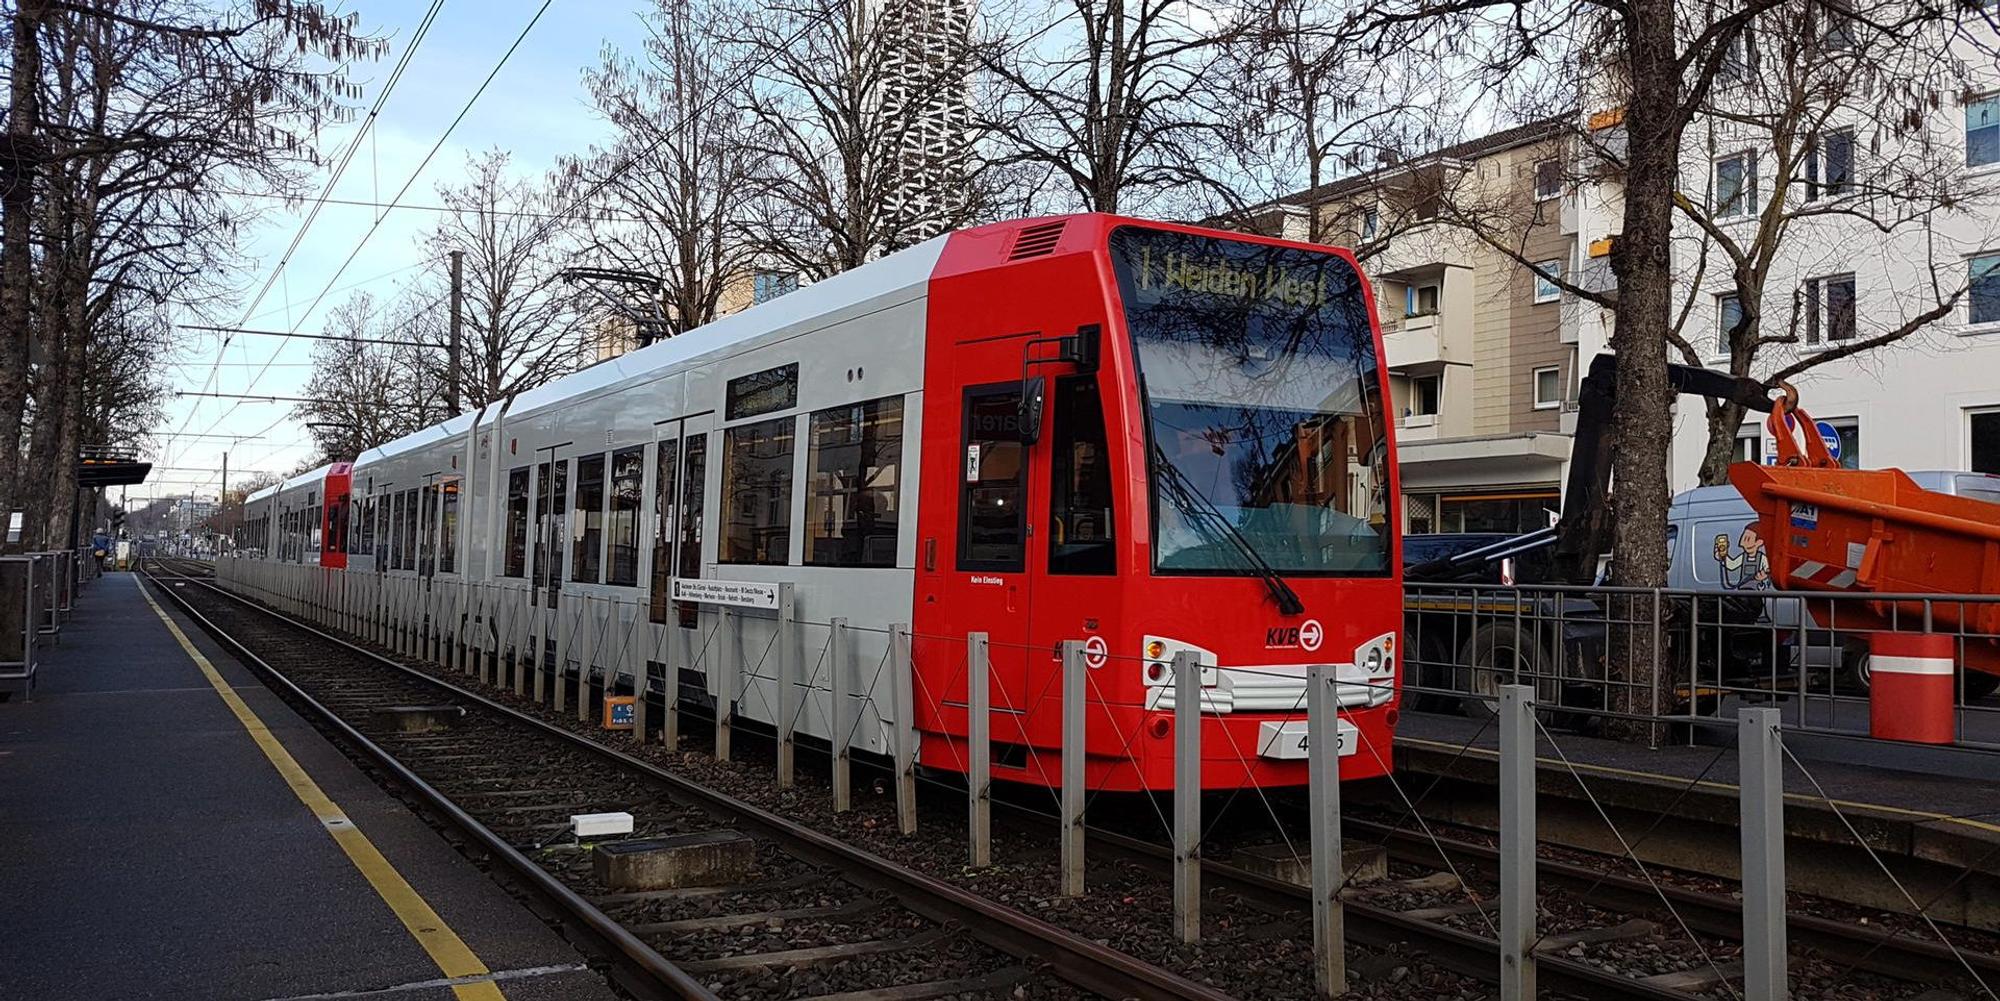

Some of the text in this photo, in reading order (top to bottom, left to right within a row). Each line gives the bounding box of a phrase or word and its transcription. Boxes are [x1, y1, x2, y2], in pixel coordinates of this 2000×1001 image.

[1166, 251, 1256, 299] Weiden
[1265, 264, 1327, 306] West
[970, 575, 982, 584] Kein
[1266, 627, 1299, 645] KVB
